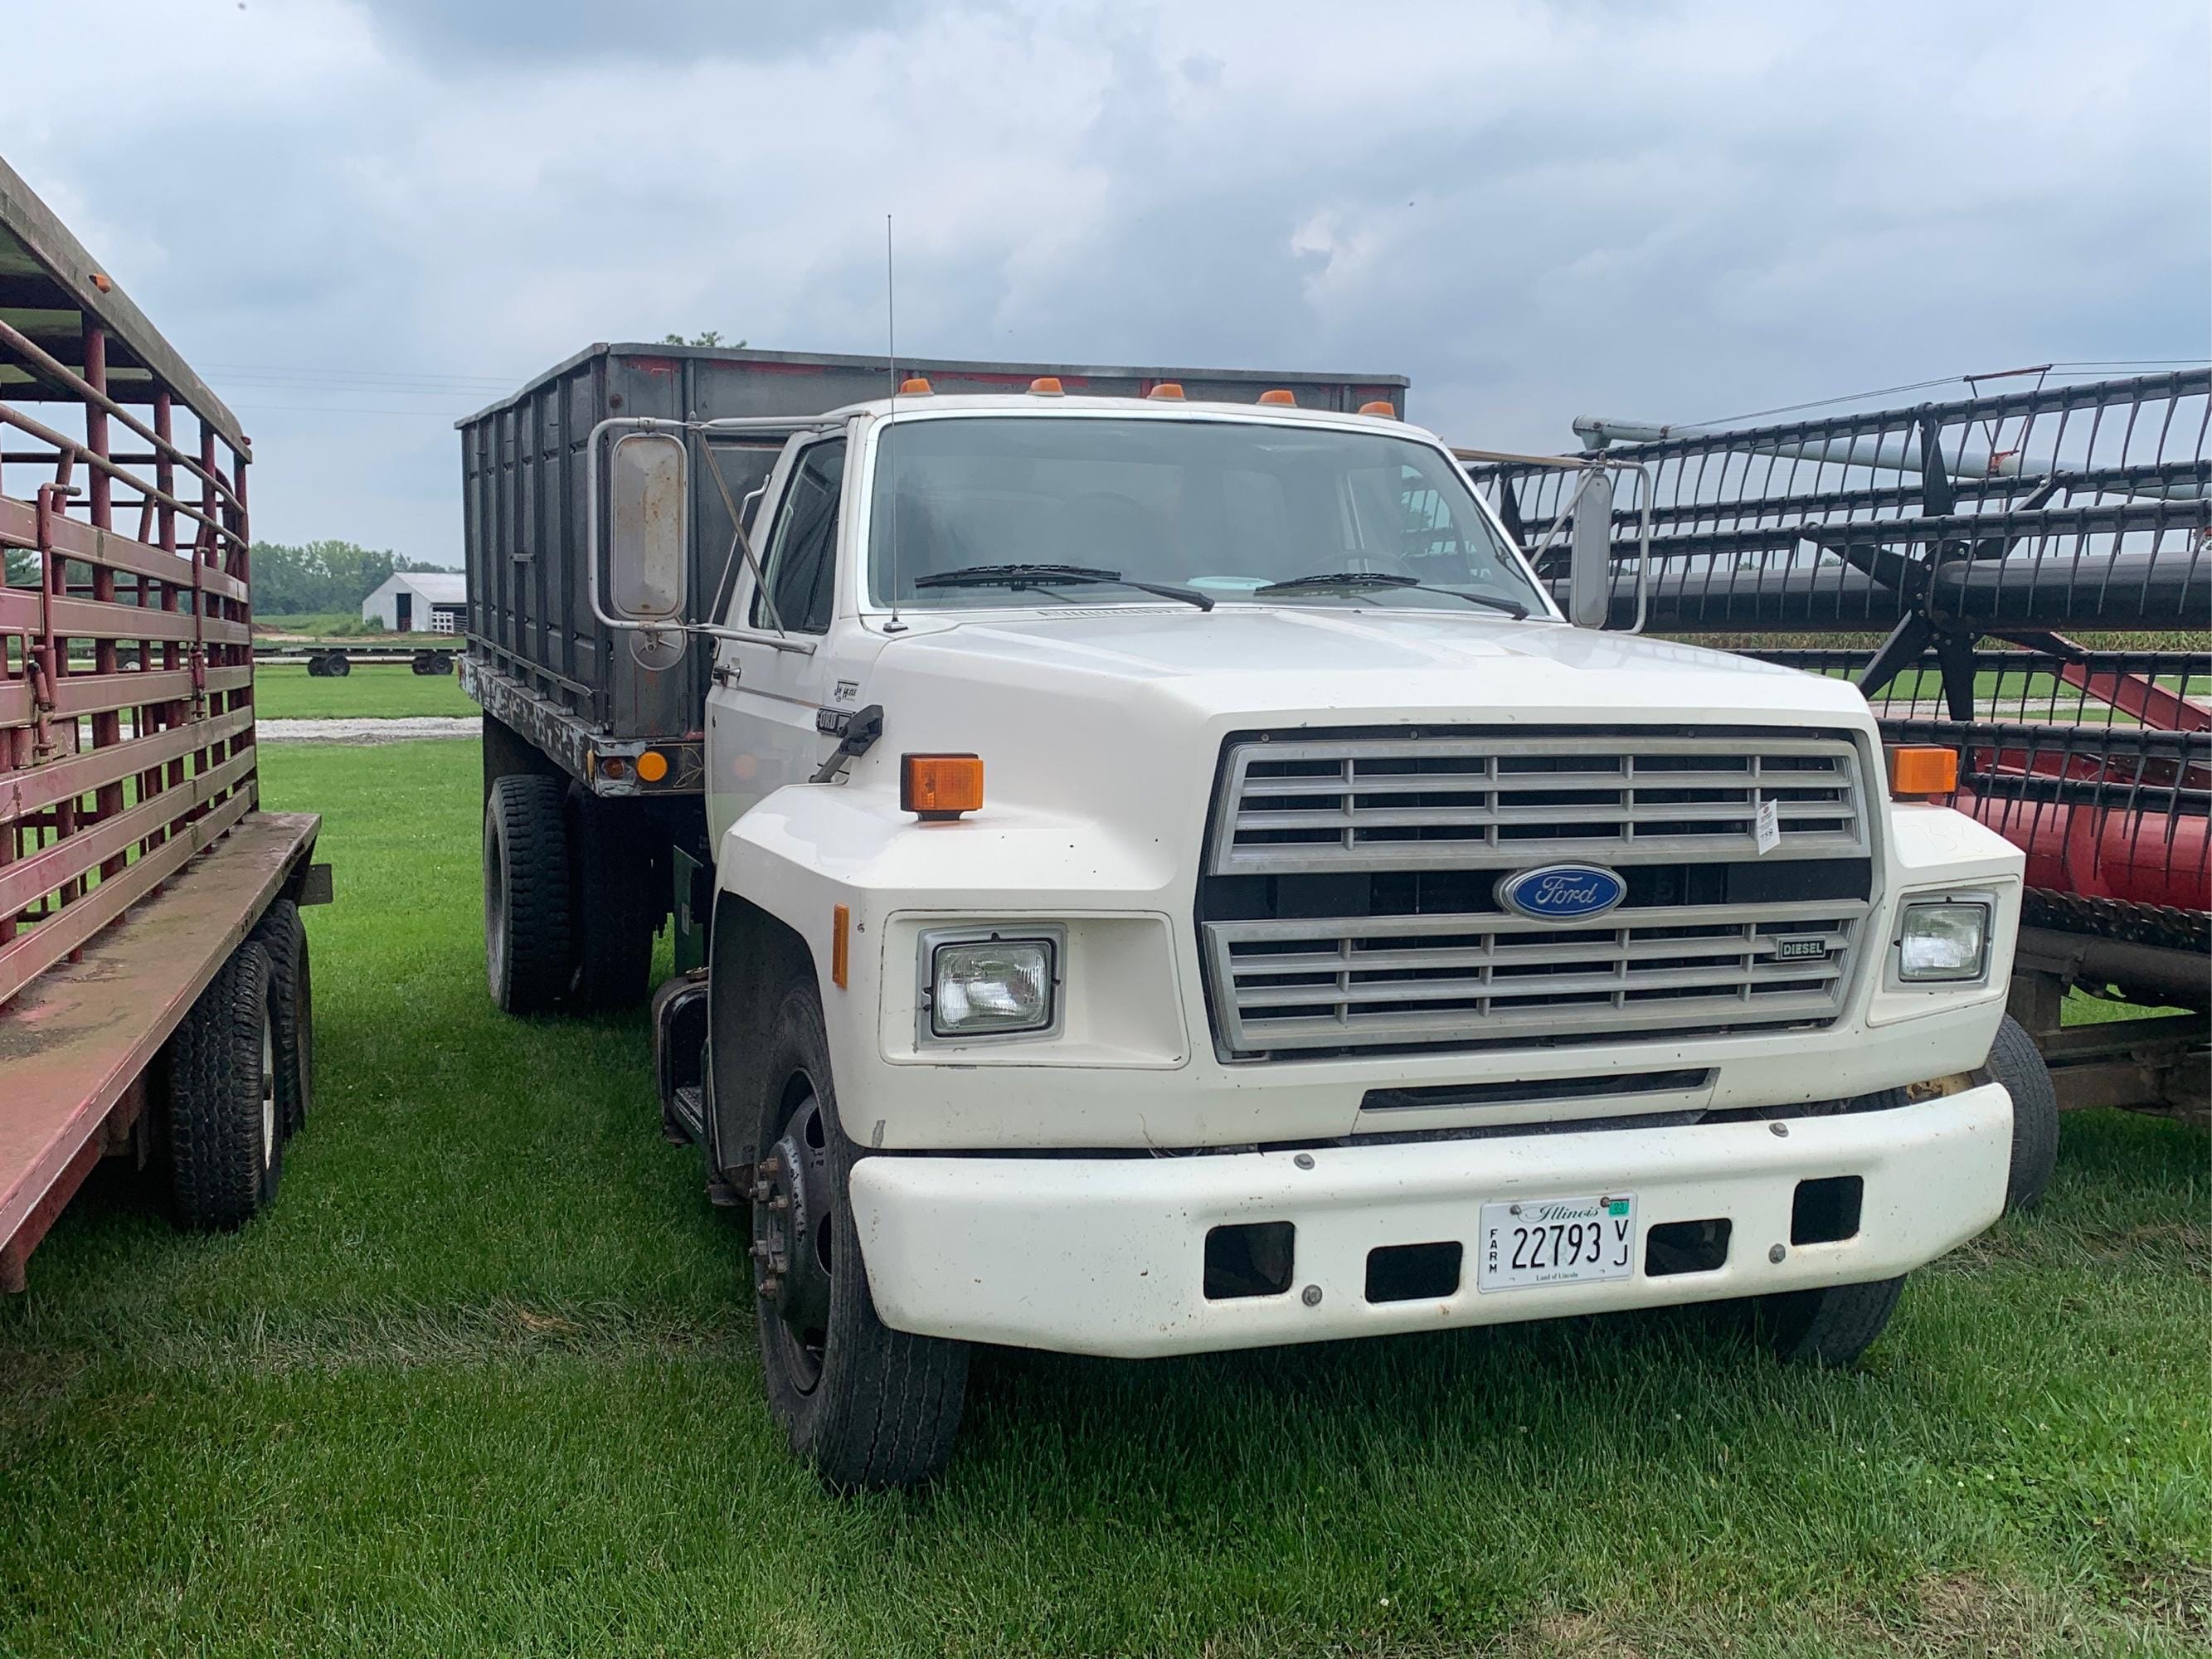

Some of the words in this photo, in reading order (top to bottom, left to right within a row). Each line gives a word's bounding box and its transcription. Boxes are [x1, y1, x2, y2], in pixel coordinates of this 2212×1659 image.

[1535, 876, 1598, 905] Ford
[1782, 941, 1823, 955] DIESEL
[1519, 1204, 1601, 1224] Illinois
[1489, 1228, 1498, 1273] FARM
[1512, 1222, 1601, 1269] 22793
[1536, 1273, 1550, 1282] Land
[1558, 1271, 1578, 1279] Lincoln
